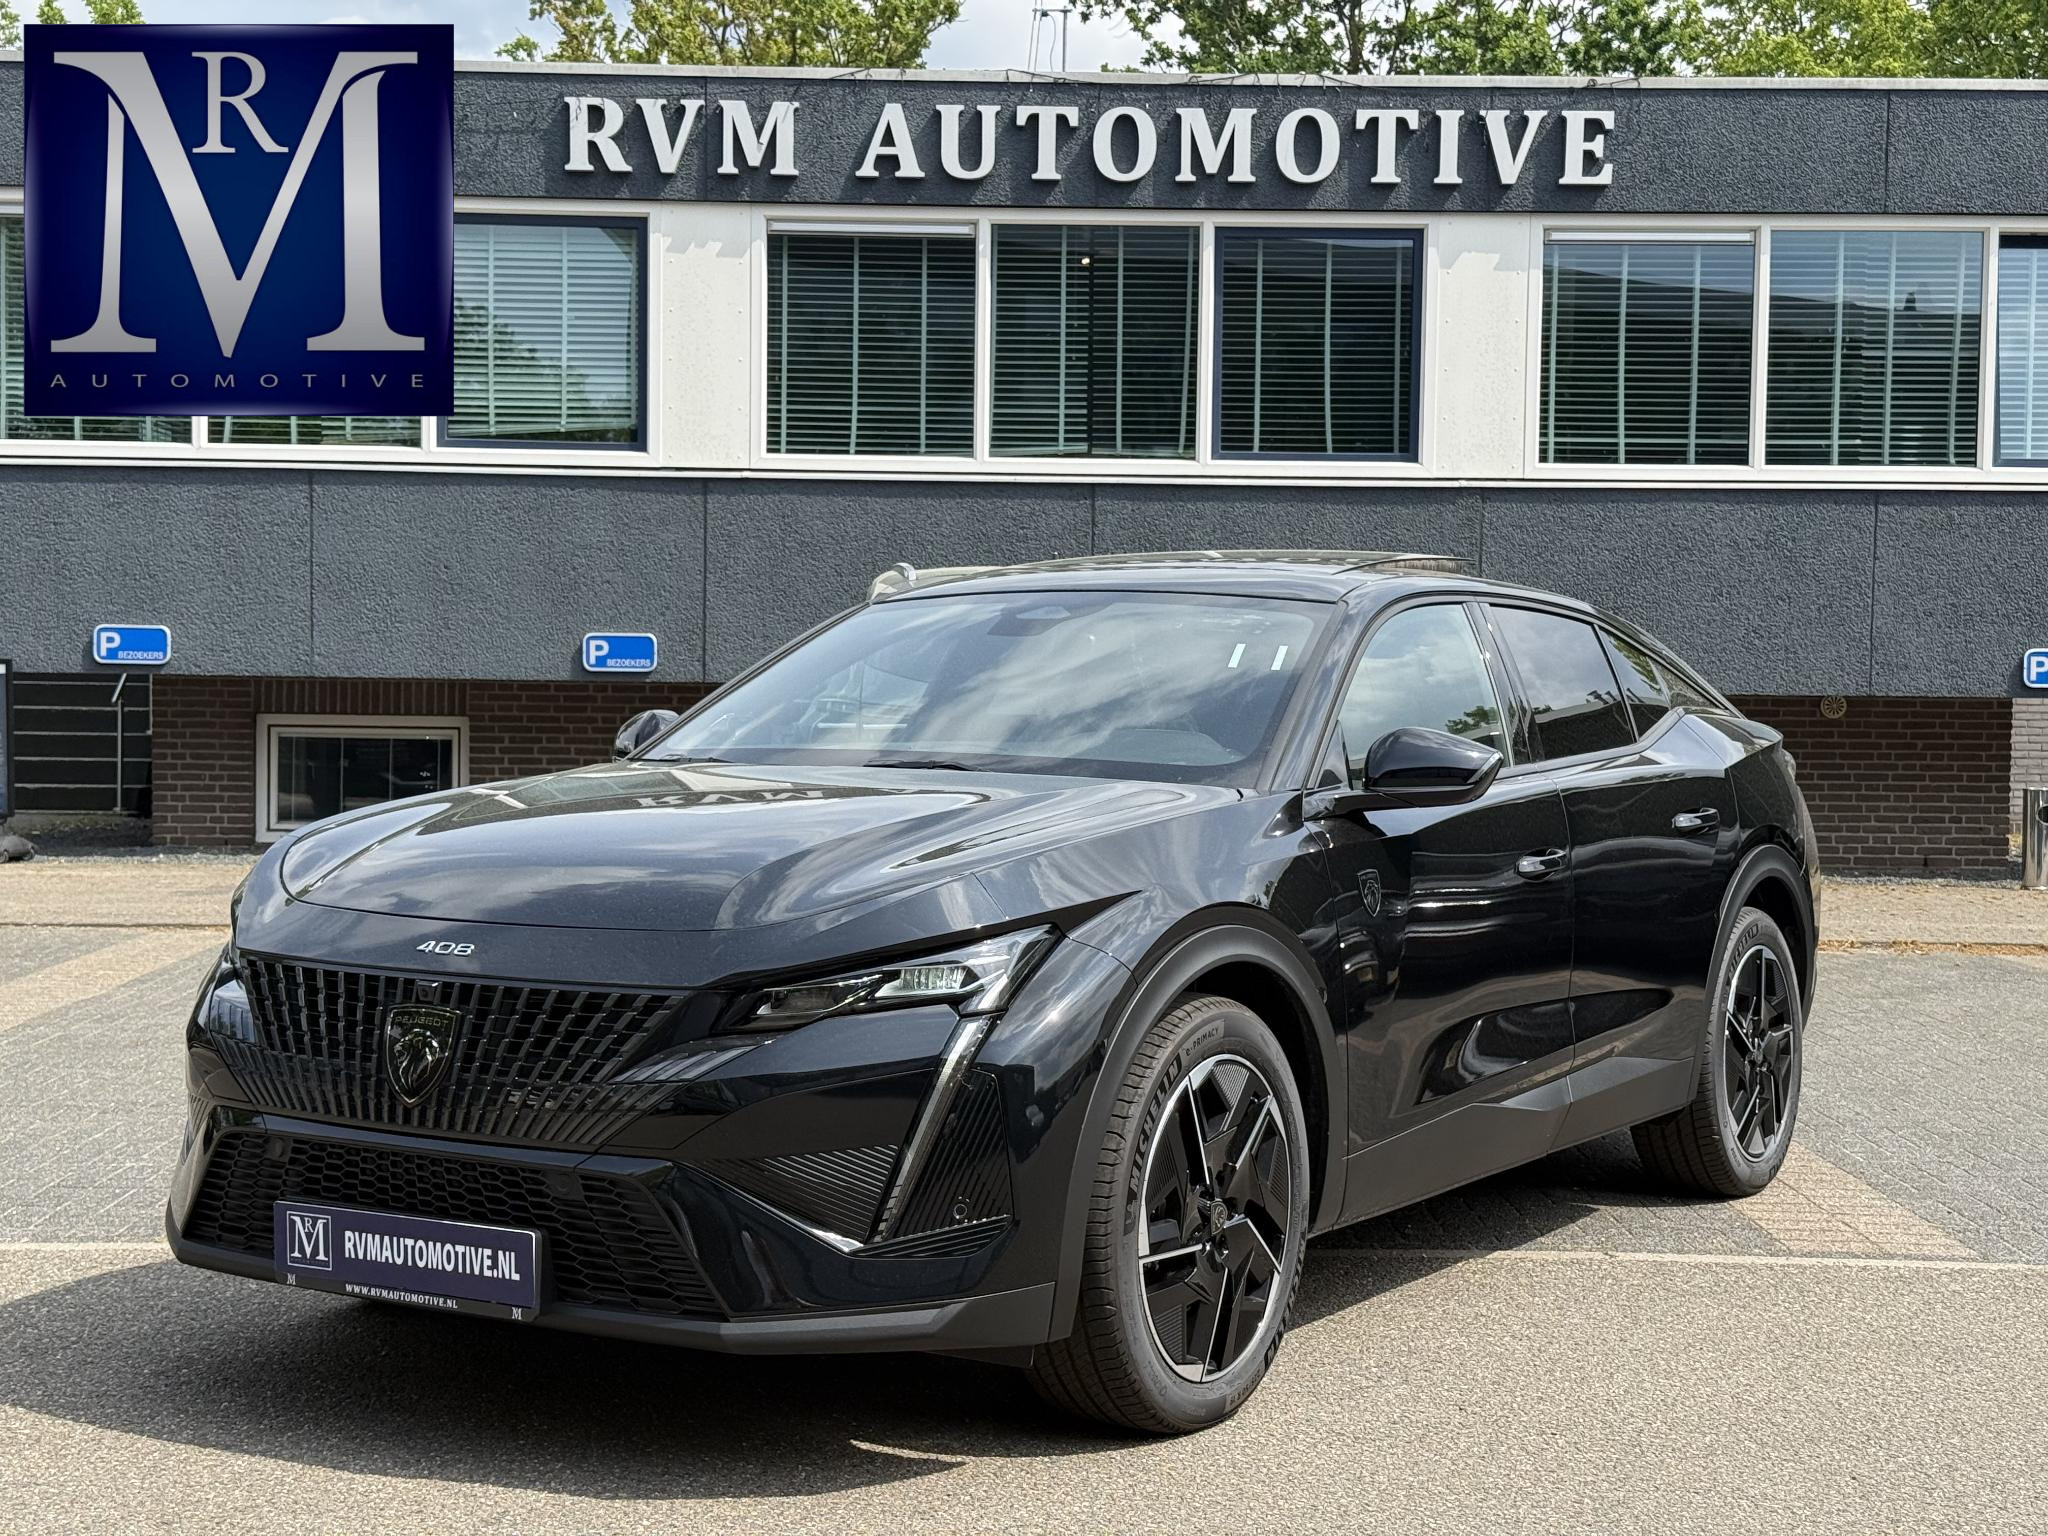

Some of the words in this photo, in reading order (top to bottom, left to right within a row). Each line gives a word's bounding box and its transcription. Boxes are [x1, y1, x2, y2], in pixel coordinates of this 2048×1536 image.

[564, 97, 799, 177] RVM
[855, 102, 1616, 186] AUTOMOTIVE
[100, 631, 121, 656] P
[118, 651, 163, 660] BEZOEKERS
[589, 639, 609, 665] P
[607, 659, 651, 667] BEZOEKERS
[2030, 656, 2048, 681] P
[416, 940, 475, 956] 408
[395, 1015, 449, 1028] PEUGEOT
[1129, 1054, 1180, 1194] MICHELIN
[344, 1230, 520, 1281] RVMAUTOMOTIVE.NL
[345, 1283, 458, 1309] WWW.RVMAUTOMOTIVE.NL
